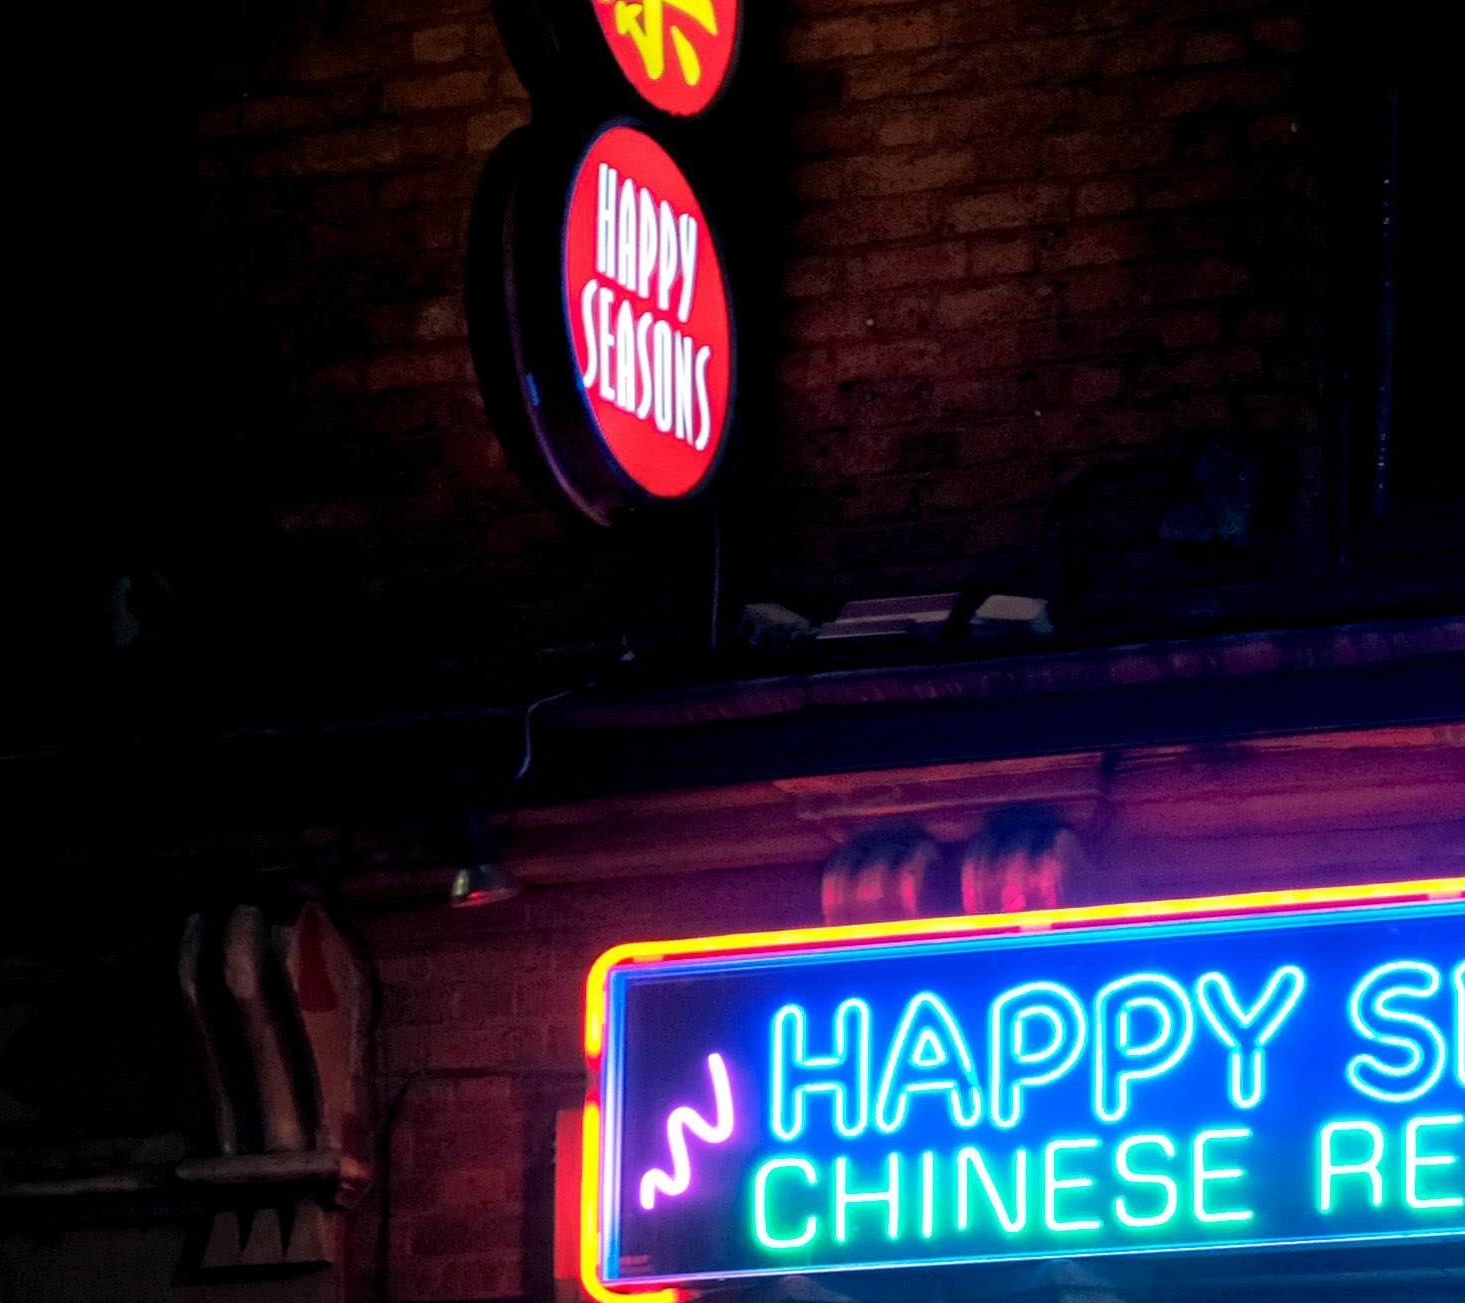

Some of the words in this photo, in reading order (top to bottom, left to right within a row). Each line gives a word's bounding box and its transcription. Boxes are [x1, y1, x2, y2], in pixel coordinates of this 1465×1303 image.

[596, 163, 698, 322] HAPPY
[582, 278, 711, 451] SEASONS
[768, 963, 1307, 1142] HAPPY
[750, 1126, 1255, 1253] CHINESE
